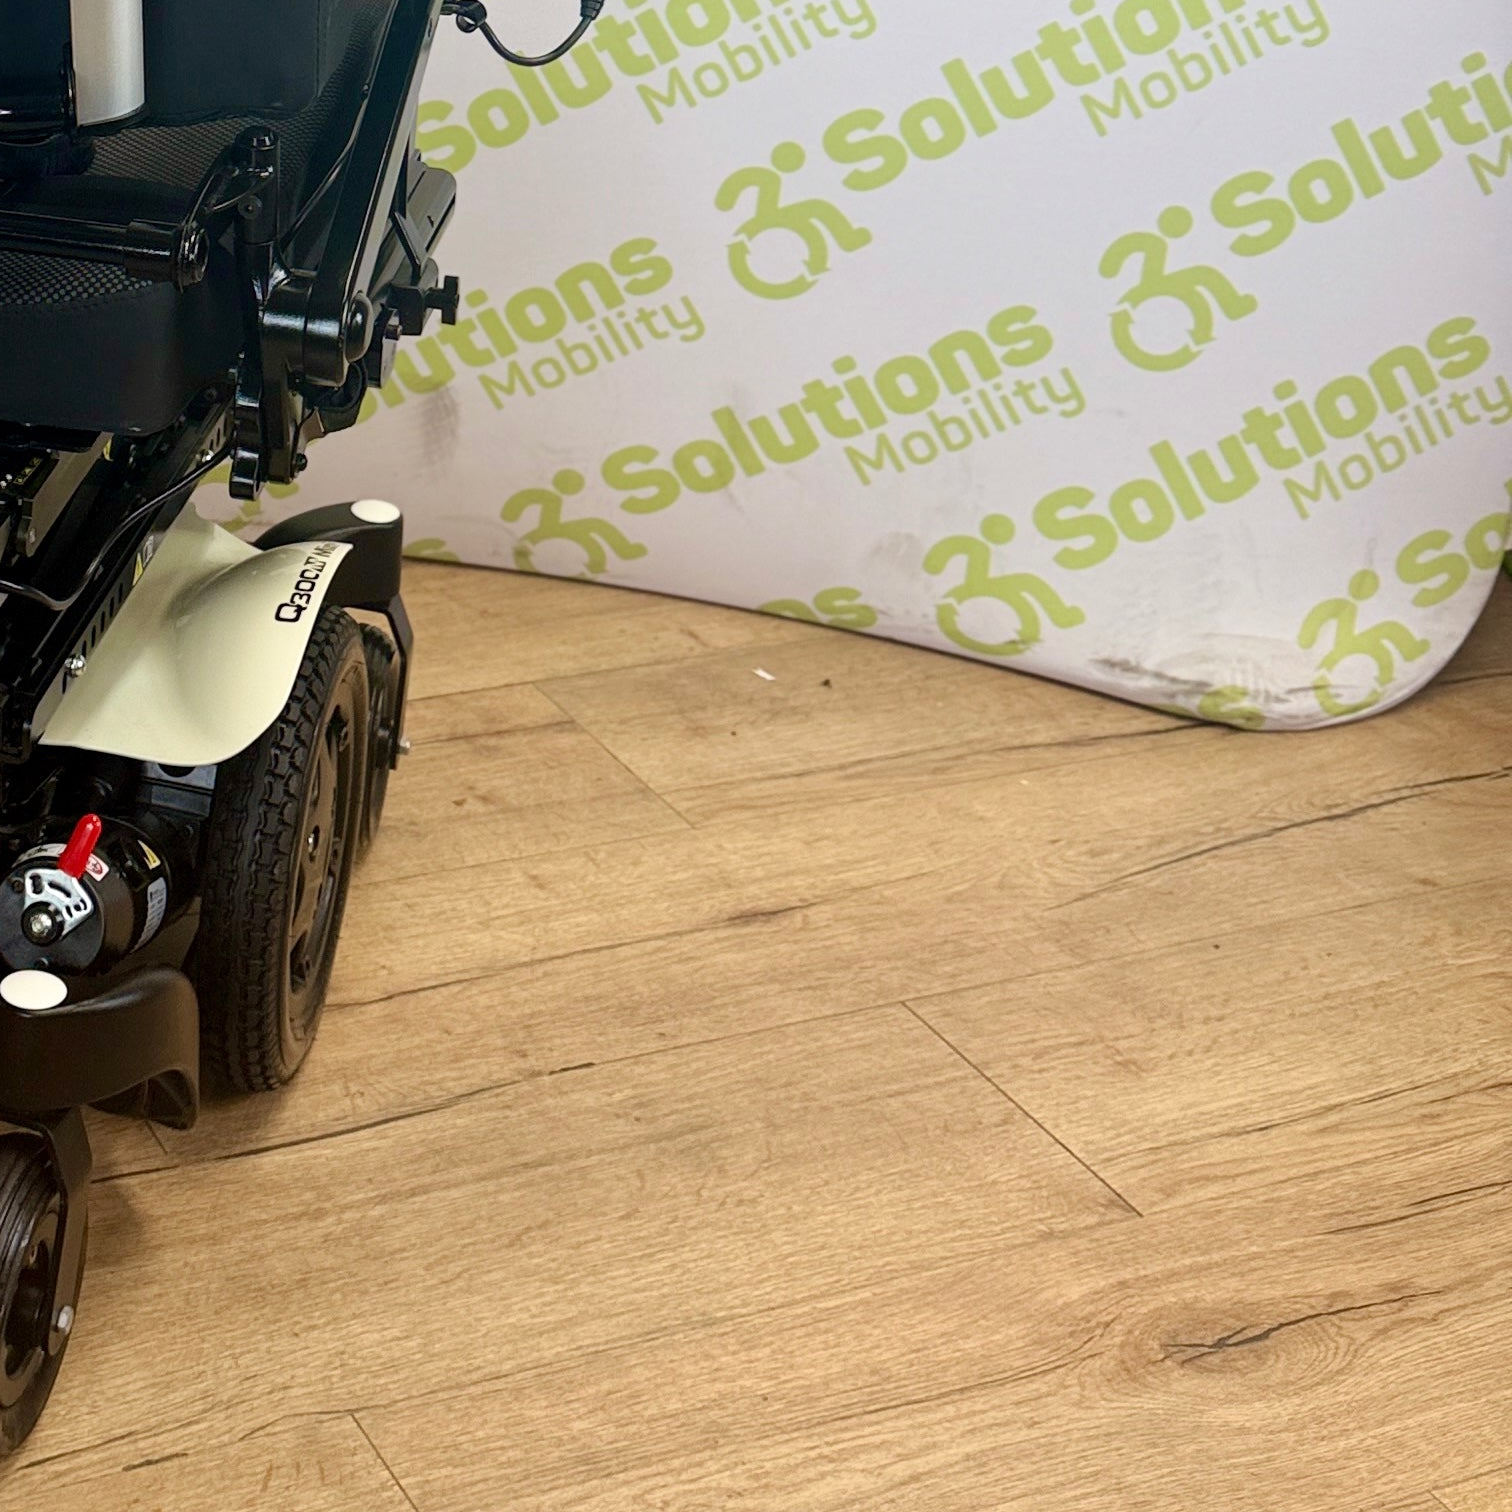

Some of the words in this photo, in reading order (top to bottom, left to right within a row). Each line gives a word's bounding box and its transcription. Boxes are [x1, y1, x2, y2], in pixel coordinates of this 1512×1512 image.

[1210, 51, 1512, 258] Soluti
[356, 237, 674, 425] utions
[477, 295, 706, 411] Mobility
[600, 304, 1055, 516] Solutions
[842, 366, 1087, 488] Mobility
[1032, 316, 1491, 571] Solutions
[1283, 375, 1512, 522] Mobility
